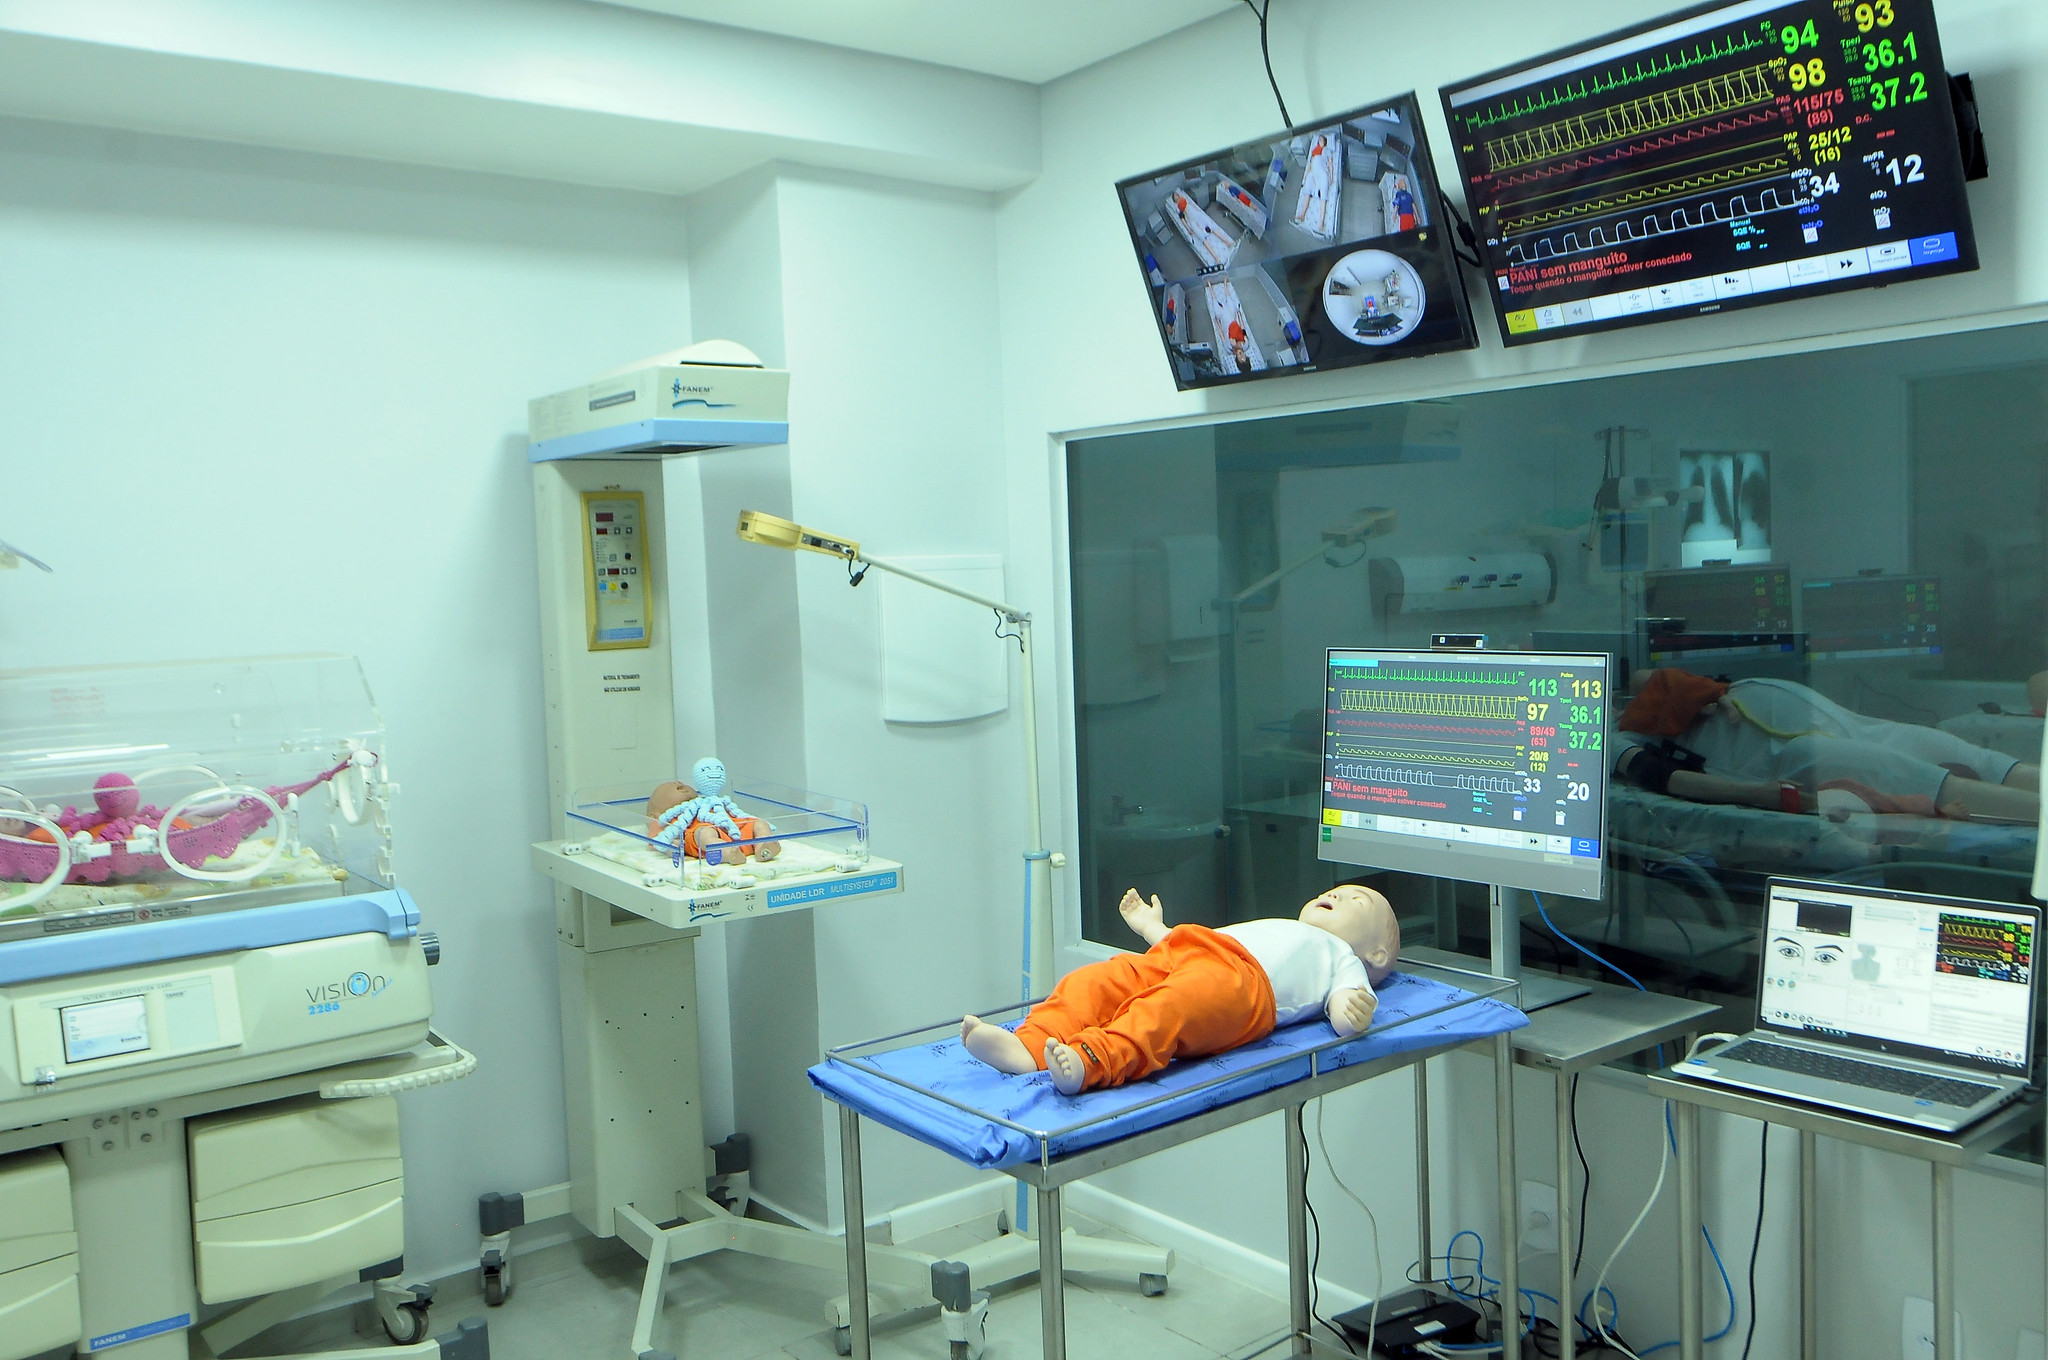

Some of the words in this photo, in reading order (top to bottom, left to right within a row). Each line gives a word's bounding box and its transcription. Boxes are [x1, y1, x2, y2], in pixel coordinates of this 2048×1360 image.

[1855, 0, 1894, 33] 93
[1780, 19, 1819, 54] 94
[1862, 31, 1917, 72] 36.1
[1788, 57, 1826, 92] 98
[1793, 88, 1844, 114] 115/75
[1869, 71, 1928, 111] 37.2
[1807, 108, 1834, 129] (89)
[1808, 126, 1852, 151] 25/12
[1814, 146, 1841, 166] (16)
[1885, 153, 1925, 186] 12
[1809, 171, 1840, 198] 34
[1509, 268, 1538, 284] PANI
[1541, 264, 1566, 280] sem
[1569, 251, 1628, 273] manguito
[1509, 284, 1533, 295] Toque
[1534, 277, 1565, 290] quando
[1573, 268, 1612, 283] manguito
[1614, 262, 1644, 275] estiver
[1645, 252, 1693, 269] conectado
[1529, 678, 1558, 697] 113
[1571, 679, 1602, 699] 113
[1527, 703, 1549, 721] 97
[1569, 705, 1601, 725] 36.1
[1530, 725, 1555, 737] 89/49
[1568, 730, 1602, 751] 37.2
[1531, 737, 1547, 747] (63)
[1529, 750, 1549, 762] 20/8
[1530, 762, 1547, 773] (12)
[1332, 781, 1351, 791] PANI
[1352, 785, 1369, 793] sem
[1370, 787, 1409, 798] manguito
[1523, 778, 1541, 793] 33
[1567, 781, 1590, 802] 20
[808, 887, 825, 897] LDR
[697, 901, 720, 910] FANEM
[308, 1001, 340, 1015] 2286
[94, 1334, 126, 1347] FANEM
